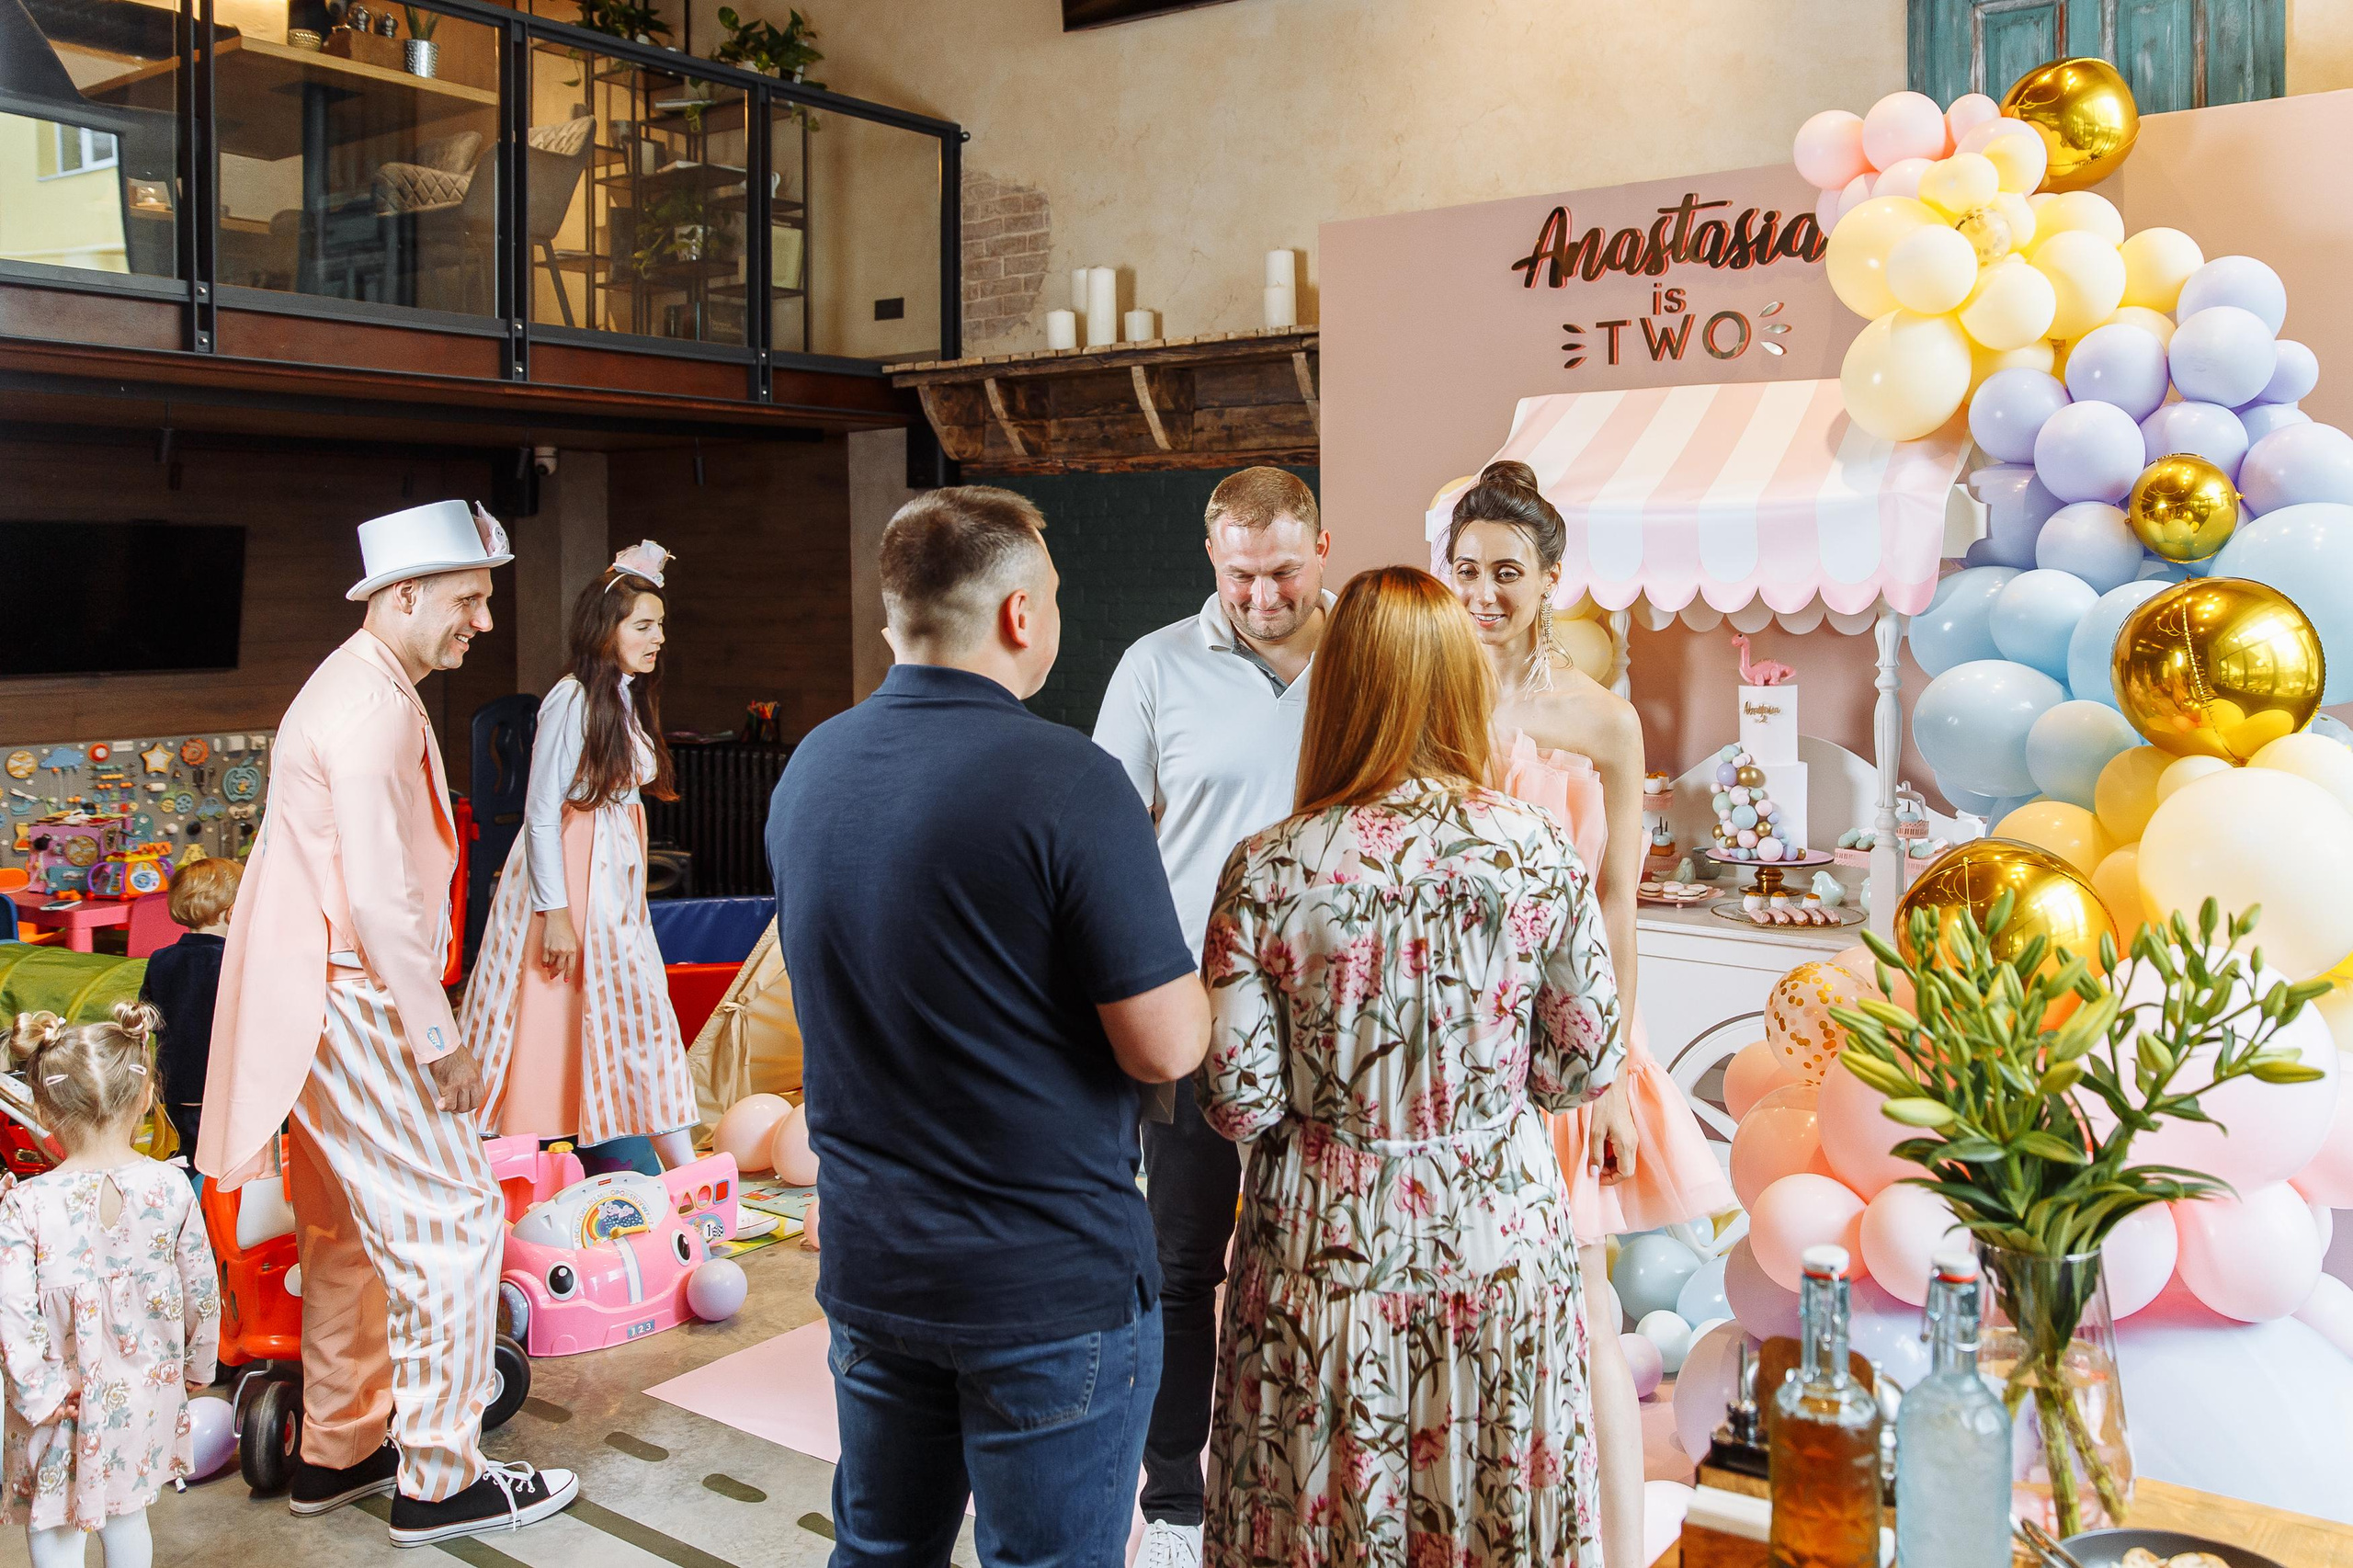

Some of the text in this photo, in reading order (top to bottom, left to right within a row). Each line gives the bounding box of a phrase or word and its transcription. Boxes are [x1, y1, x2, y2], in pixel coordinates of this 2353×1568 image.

[1511, 194, 1827, 289] Anastasia
[1653, 282, 1687, 315] is
[1596, 311, 1752, 365] TWO
